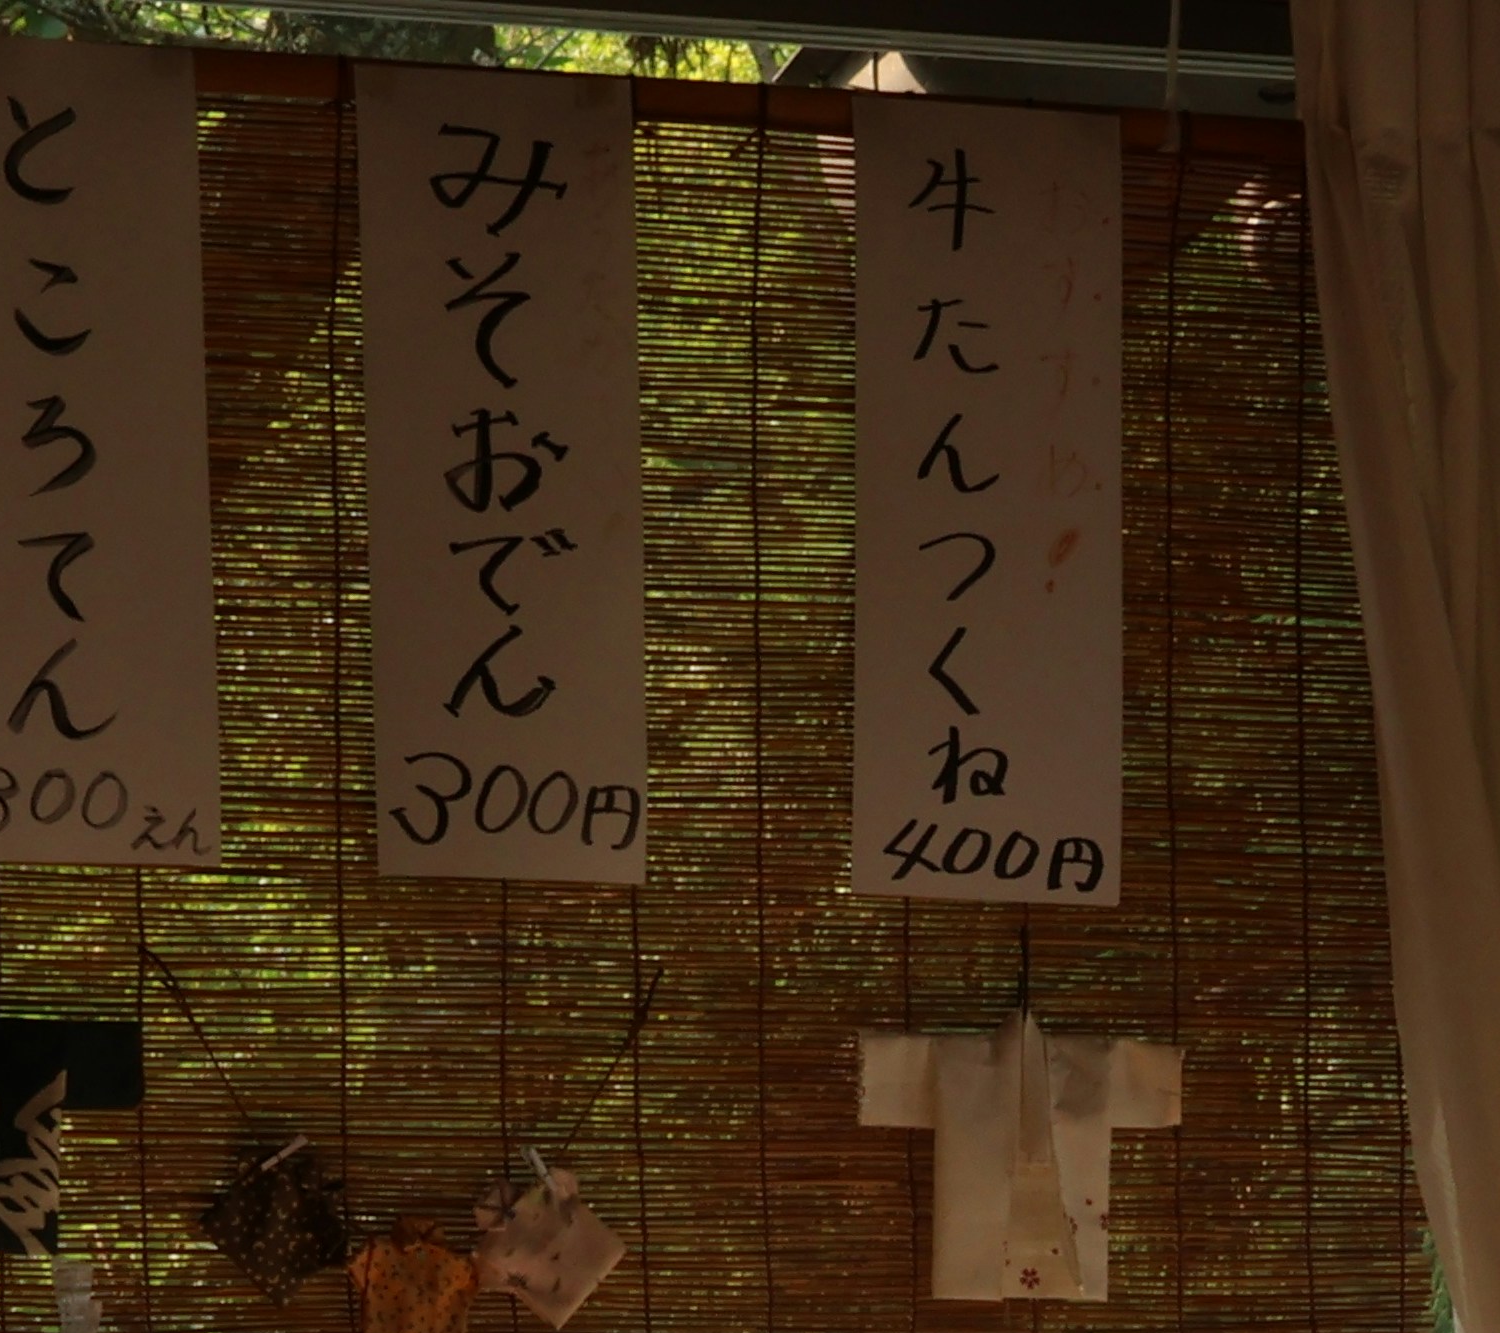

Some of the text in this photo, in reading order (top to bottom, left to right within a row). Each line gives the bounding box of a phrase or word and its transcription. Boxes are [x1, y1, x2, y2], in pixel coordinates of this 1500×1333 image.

[3, 95, 118, 741] ところてん
[429, 121, 578, 719] みそおでん
[907, 146, 1011, 806] 牛たんつくね
[388, 750, 641, 851] 300円
[881, 818, 1105, 894] 400円
